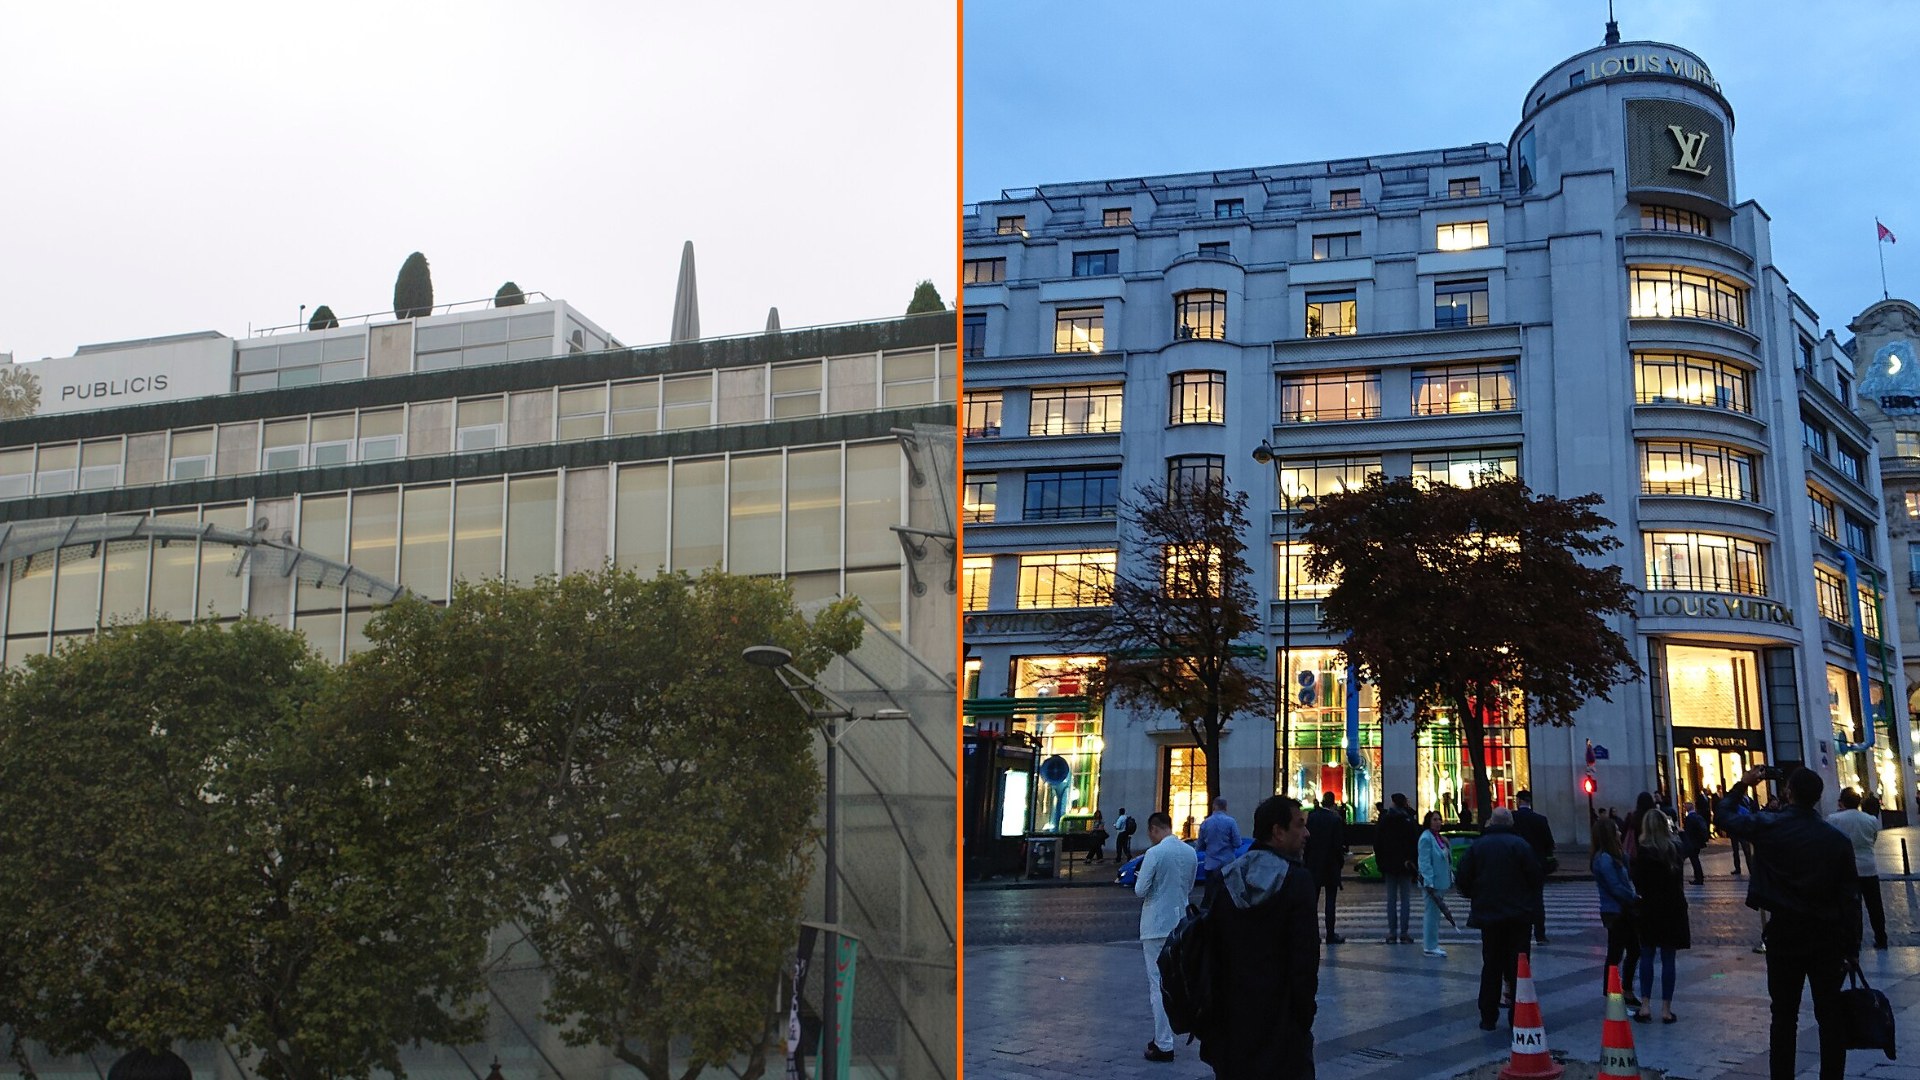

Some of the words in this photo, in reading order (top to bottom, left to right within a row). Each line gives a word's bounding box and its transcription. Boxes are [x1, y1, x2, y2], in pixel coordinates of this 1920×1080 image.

[1591, 54, 1661, 80] LOUIS
[1667, 56, 1721, 93] VUITTO
[62, 375, 168, 401] PUBLICIS
[1653, 596, 1719, 617] LOUIS
[1723, 599, 1794, 626] VUITTON
[1512, 1032, 1541, 1045] MAT
